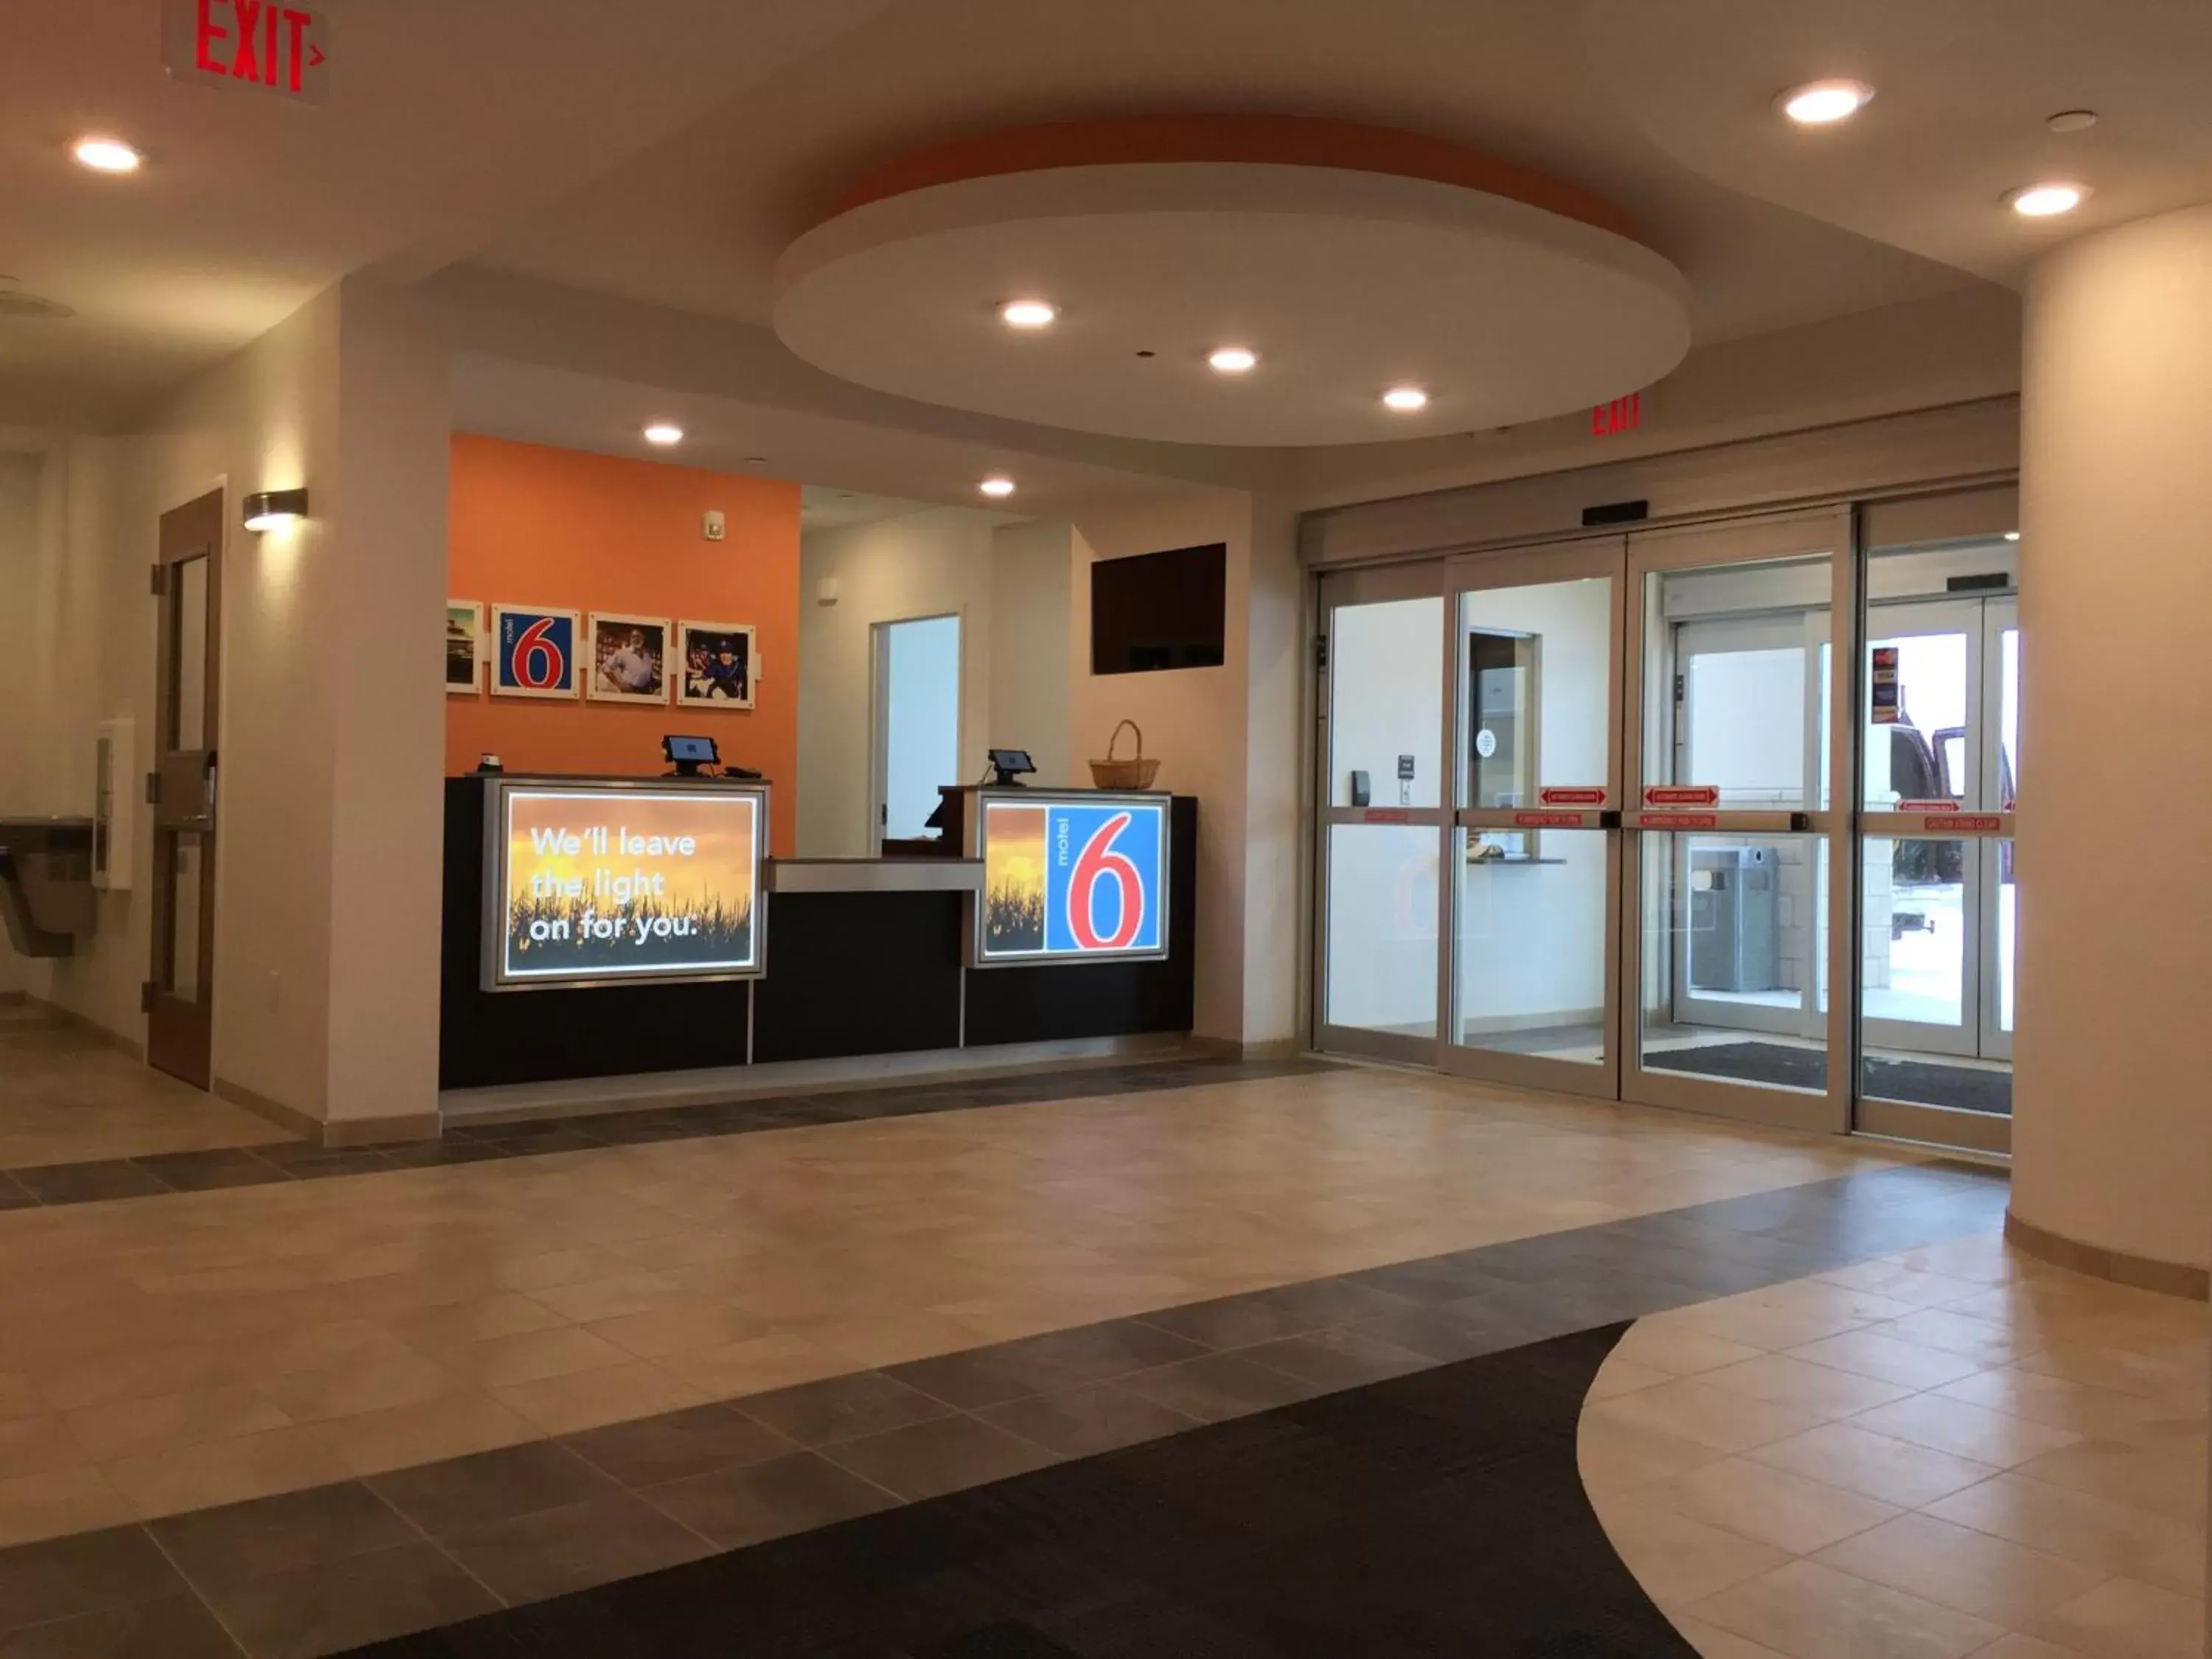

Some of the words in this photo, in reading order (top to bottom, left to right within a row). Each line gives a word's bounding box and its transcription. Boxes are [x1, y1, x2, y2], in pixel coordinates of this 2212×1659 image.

[197, 0, 310, 92] EXIT
[512, 618, 563, 689] 6
[530, 826, 608, 856] We'll
[619, 826, 697, 857] leave
[1057, 818, 1069, 866] motel
[531, 867, 582, 897] the
[594, 867, 664, 905] light
[1066, 811, 1144, 949] 6
[529, 919, 570, 941] on
[581, 906, 627, 939] for
[634, 914, 698, 945] you.
